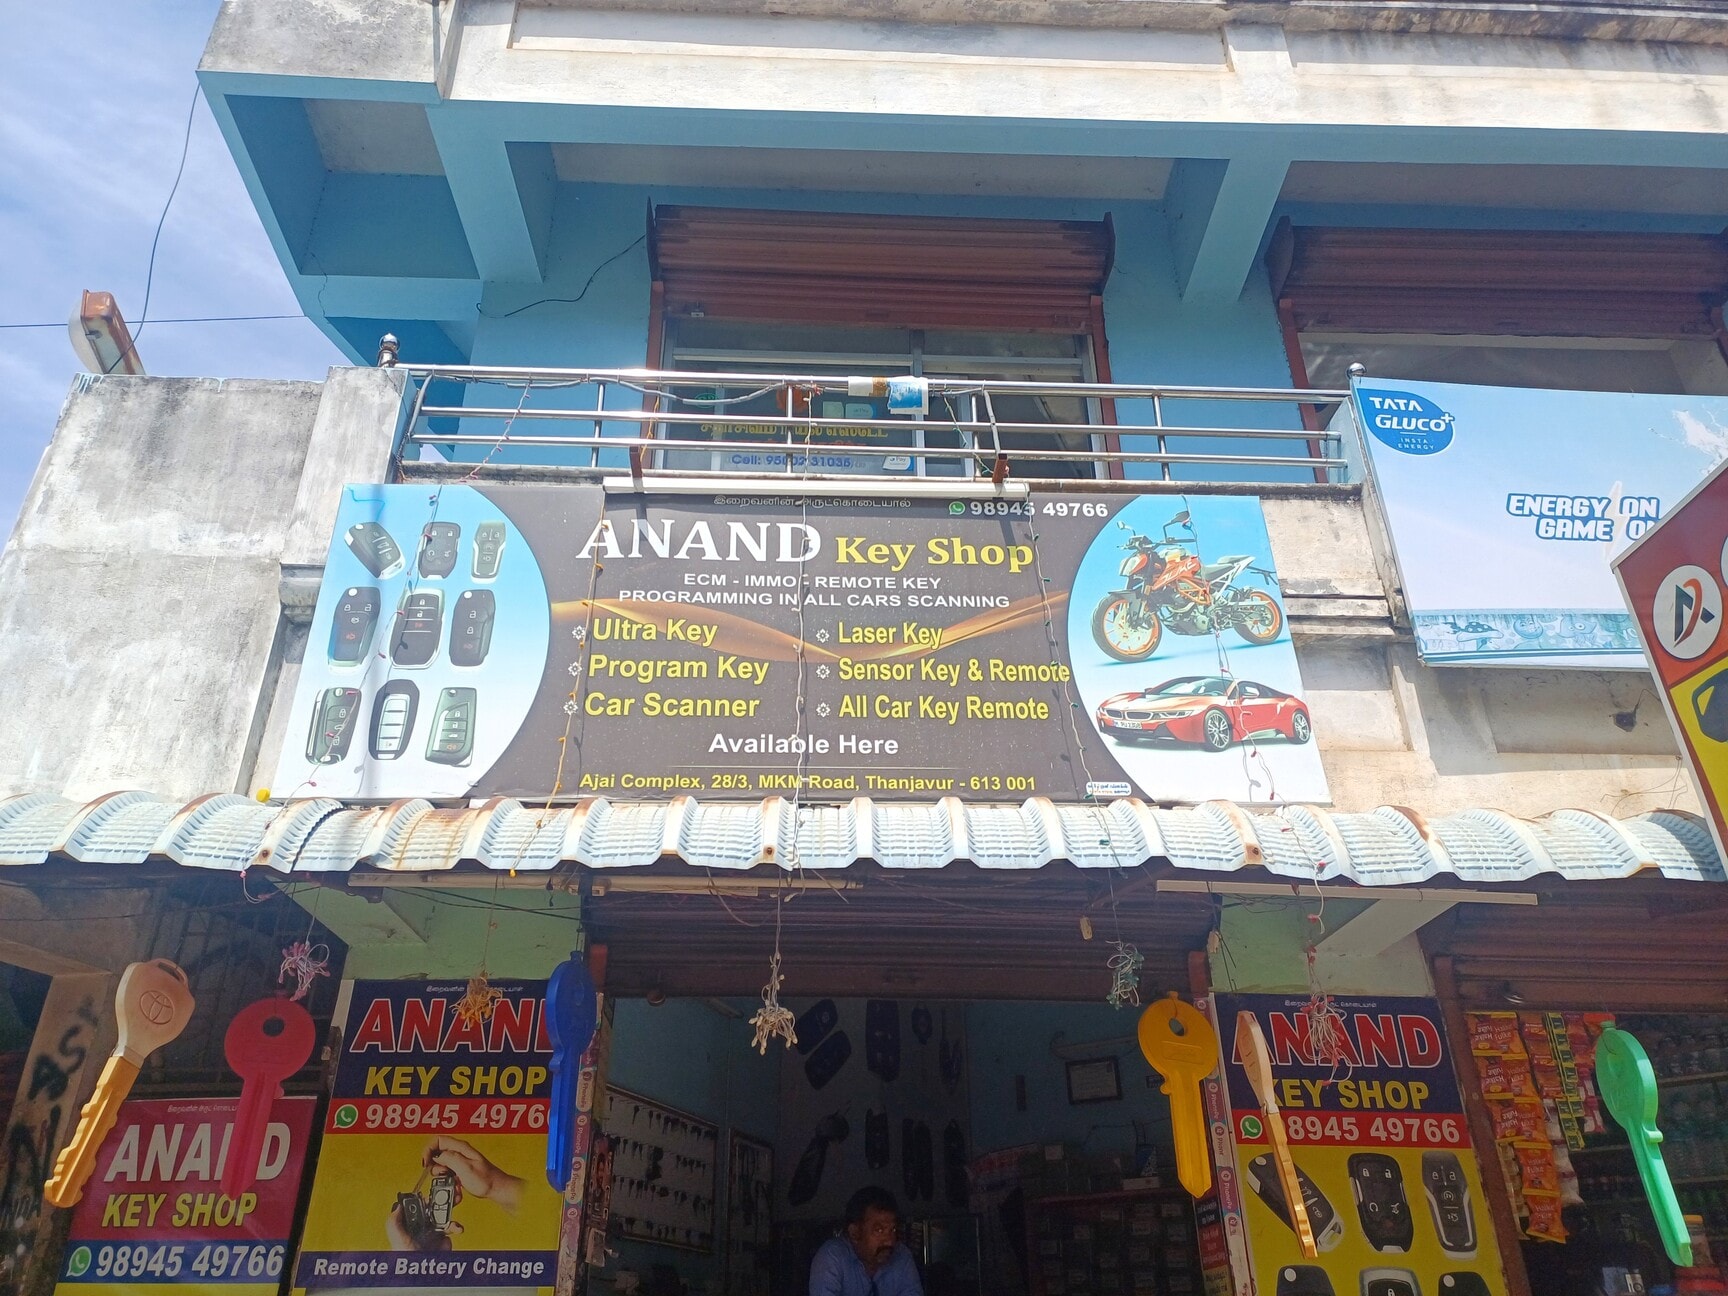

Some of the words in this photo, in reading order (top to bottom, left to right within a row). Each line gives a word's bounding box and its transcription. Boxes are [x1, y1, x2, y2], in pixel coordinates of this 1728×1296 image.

[1369, 396, 1424, 412] TATA
[714, 495, 795, 508] இறைவனின்
[970, 501, 1035, 516] 98945
[1042, 502, 1108, 517] 49766
[1507, 494, 1611, 518] ENERGY
[1620, 497, 1658, 518] ON
[575, 518, 822, 563] ANAND
[1537, 518, 1613, 540] GAME
[835, 536, 916, 572] Key
[927, 538, 1034, 573] Shop
[684, 574, 726, 586] ECM
[745, 575, 796, 588] IMMO
[814, 576, 896, 589] REMOTE
[903, 577, 942, 590] KEY
[618, 590, 772, 606] PROGRAMMING
[779, 592, 799, 606] IN
[804, 594, 841, 607] ALL
[847, 594, 902, 607] CARS
[907, 595, 1010, 608] SCANNING
[592, 618, 657, 640] Ultra
[666, 618, 718, 647] Key
[838, 622, 896, 644] Laser
[903, 622, 943, 650] Key
[588, 654, 708, 684] Program
[718, 656, 770, 685] Key
[838, 658, 914, 681] Sensor
[920, 658, 960, 686] Key
[967, 658, 984, 682] &
[989, 659, 1070, 682] Remote
[584, 692, 636, 716] Car
[643, 692, 760, 718] Scanner
[838, 694, 868, 718] All
[874, 694, 912, 718] Car
[919, 696, 960, 724] Key
[966, 696, 1049, 720] Remote
[708, 733, 830, 754] Available
[839, 734, 899, 754] Here
[580, 773, 615, 791] Ajai
[620, 774, 705, 791] Complex,
[711, 774, 752, 791] 28/3,
[758, 775, 802, 789] MKM
[808, 776, 860, 792] Road,
[866, 776, 954, 792] Thanjavur
[970, 776, 1000, 790] 613
[1006, 776, 1036, 790] 001
[364, 1066, 440, 1096] KEY
[450, 1066, 546, 1096] SHOP
[1338, 1080, 1429, 1110] SHOP
[365, 1104, 460, 1129] 98945
[470, 1103, 550, 1128] 4976
[574, 1127, 584, 1154] PhonePe
[1288, 1116, 1360, 1141] 8945
[1370, 1116, 1460, 1144] 49766
[102, 1193, 168, 1227] KEY
[172, 1192, 258, 1227] SHOP
[96, 1246, 185, 1277] 98945
[192, 1245, 284, 1277] 49766
[314, 1258, 388, 1276] Remote
[394, 1258, 467, 1279] Battery
[472, 1257, 544, 1279] Change
